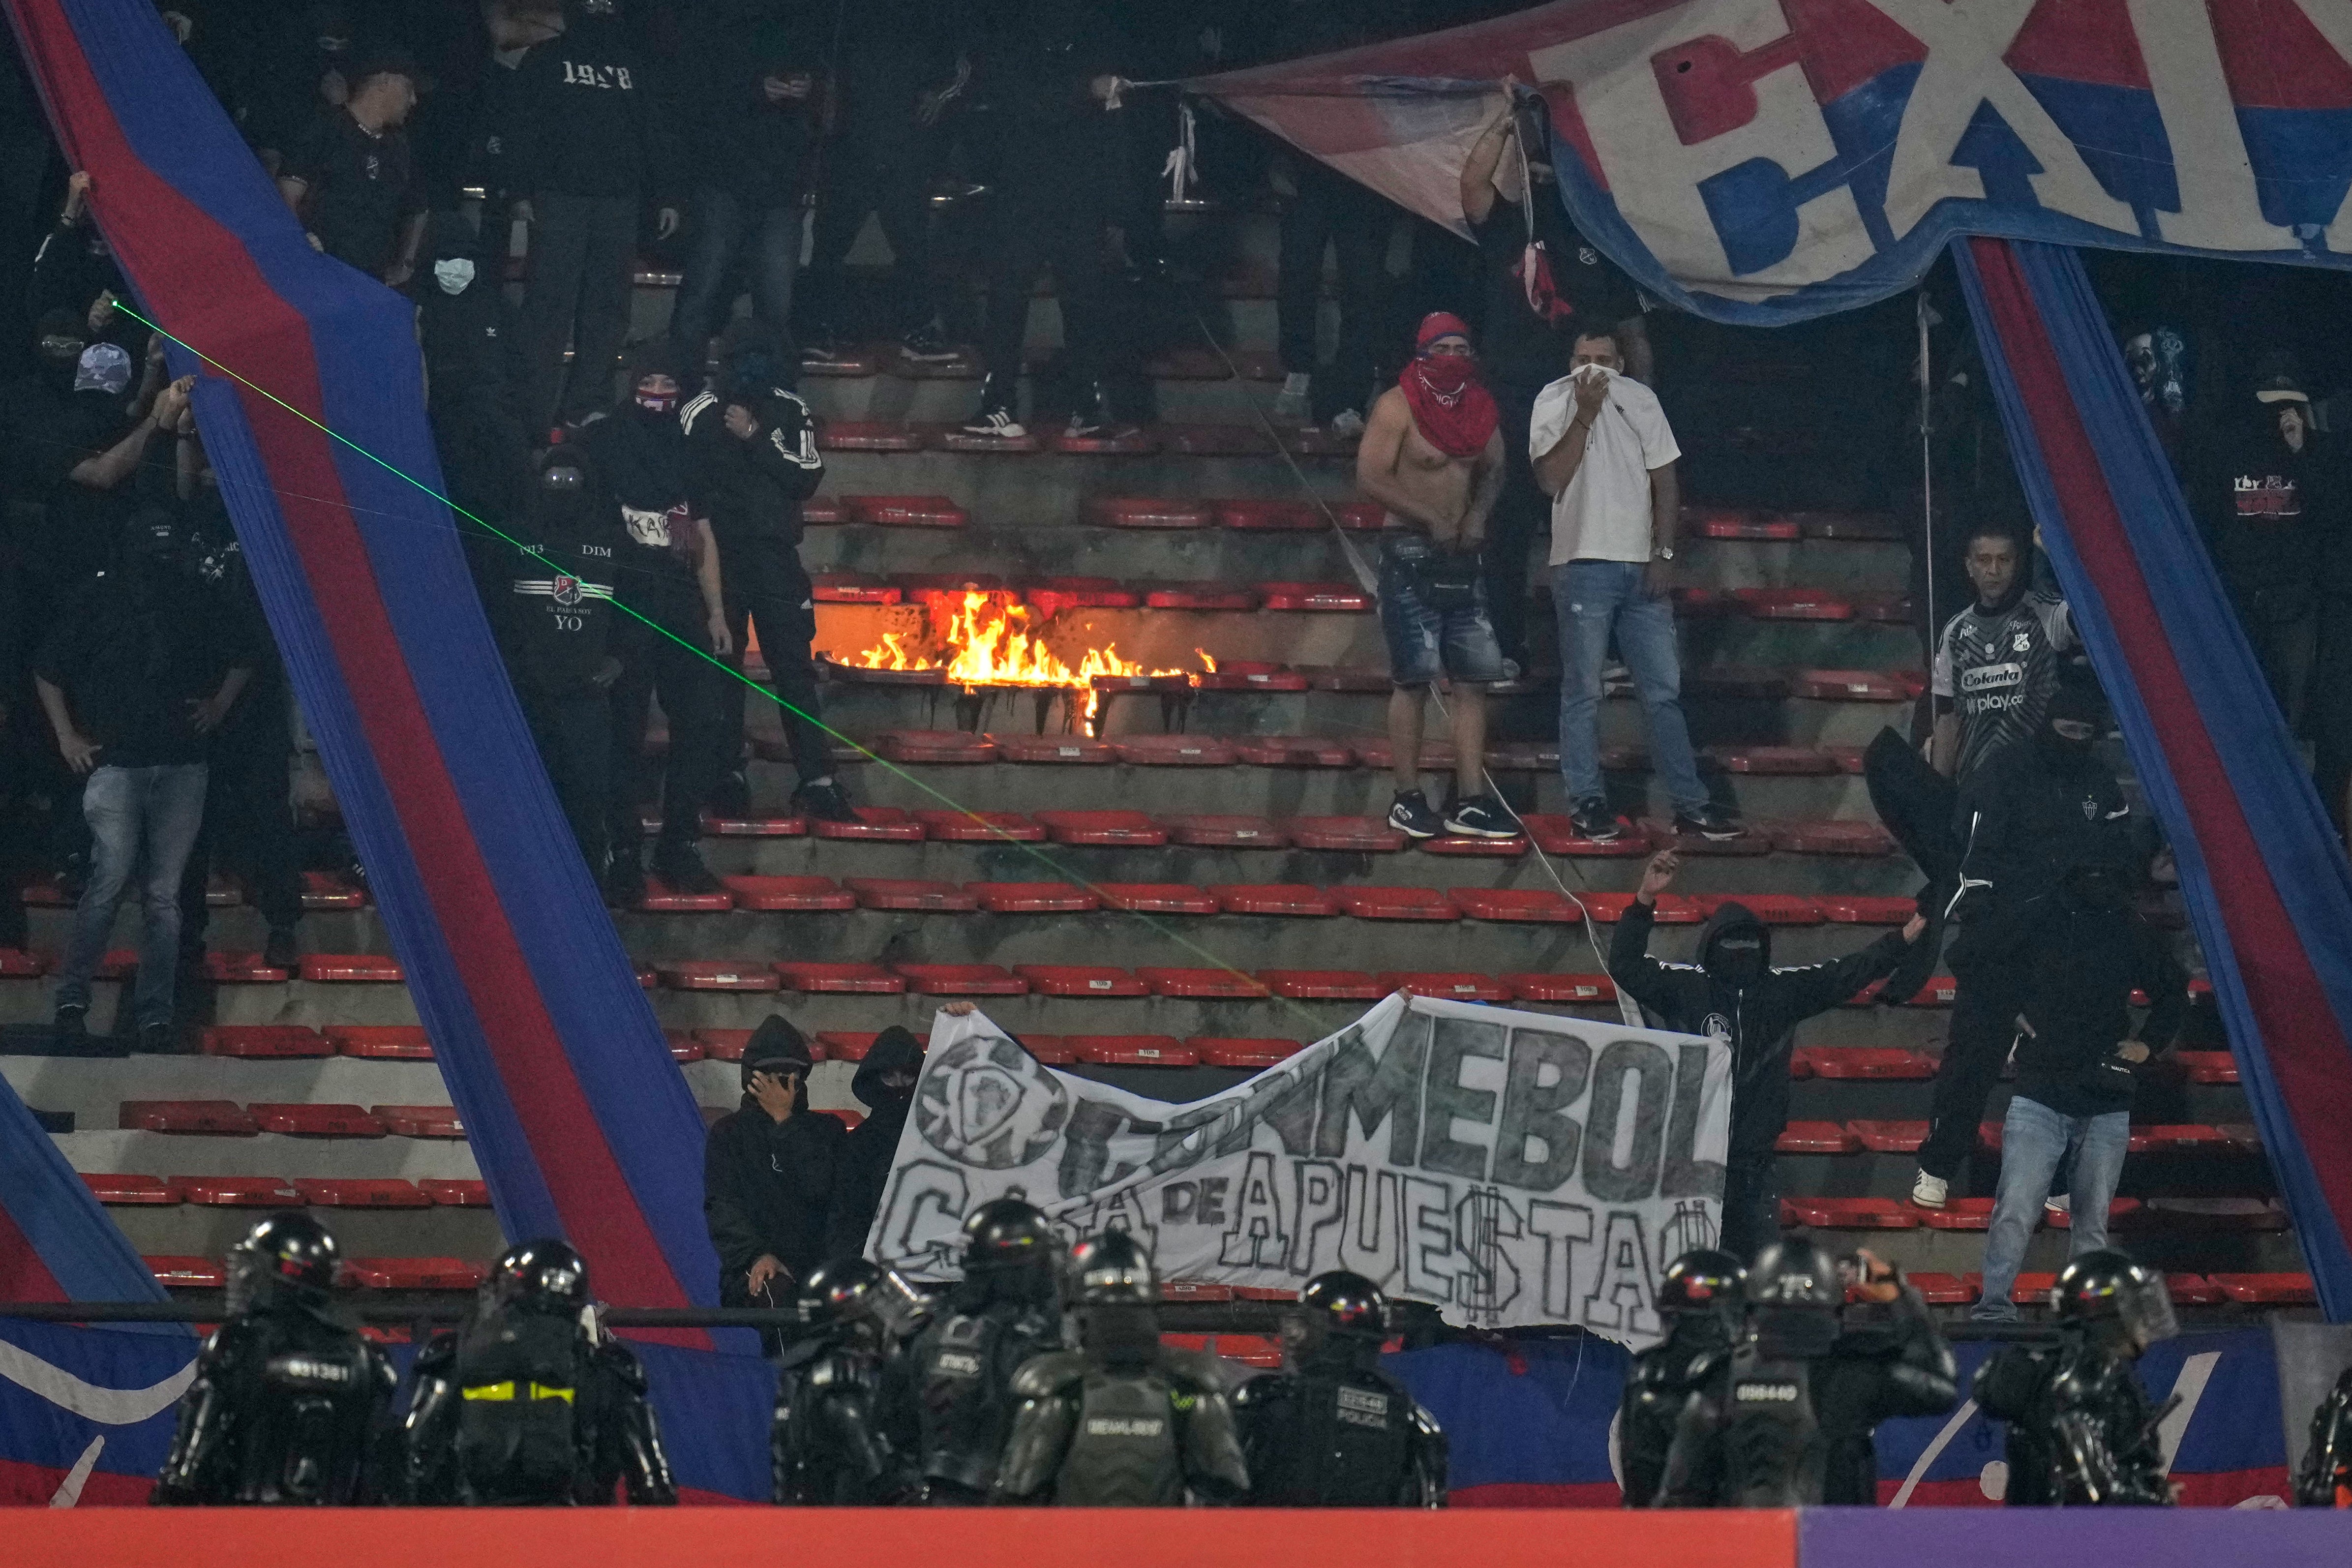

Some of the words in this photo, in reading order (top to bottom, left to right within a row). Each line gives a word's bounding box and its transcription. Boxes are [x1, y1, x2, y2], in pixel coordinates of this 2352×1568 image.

[581, 544, 611, 558] DIM
[554, 614, 582, 632] YO
[1963, 669, 2019, 687] Colanta
[1161, 1176, 1229, 1225] DE
